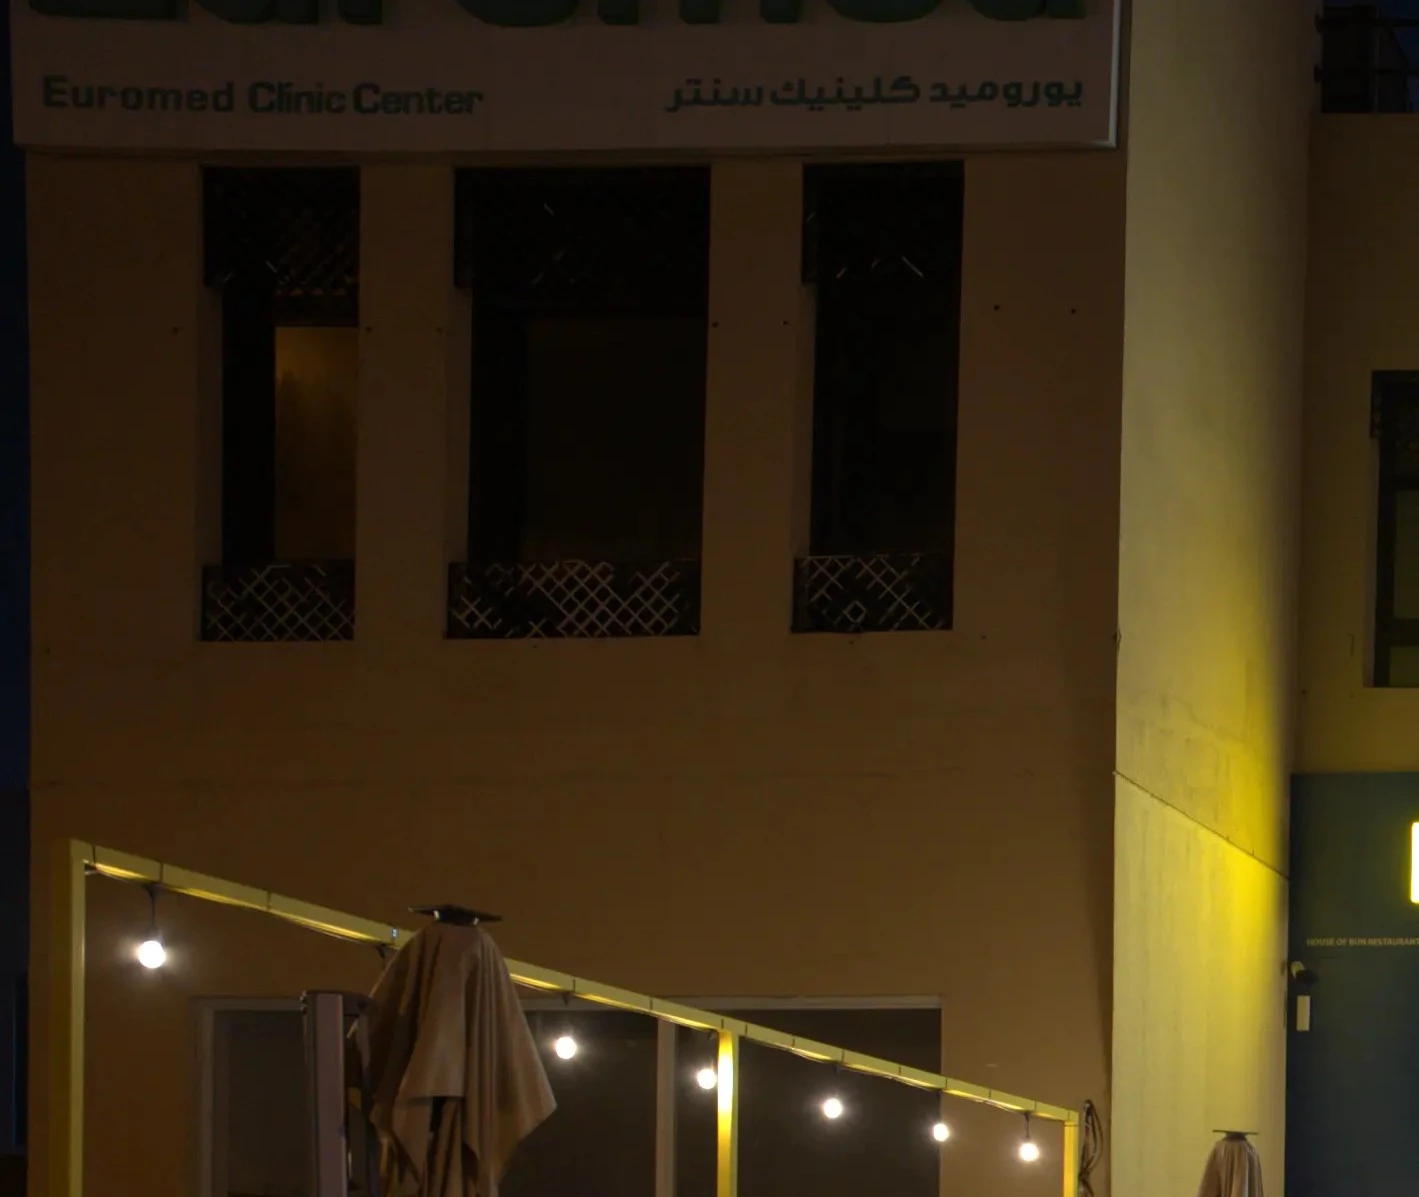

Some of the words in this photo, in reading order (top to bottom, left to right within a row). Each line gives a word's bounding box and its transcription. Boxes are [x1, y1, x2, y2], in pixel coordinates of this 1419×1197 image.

[42, 74, 235, 112] Euromed
[248, 81, 346, 115] Clinic
[353, 82, 485, 116] Center
[664, 78, 763, 112] سنتر
[769, 75, 921, 111] كلينيك
[928, 77, 1083, 108] يوروميد
[1336, 937, 1347, 946] OF
